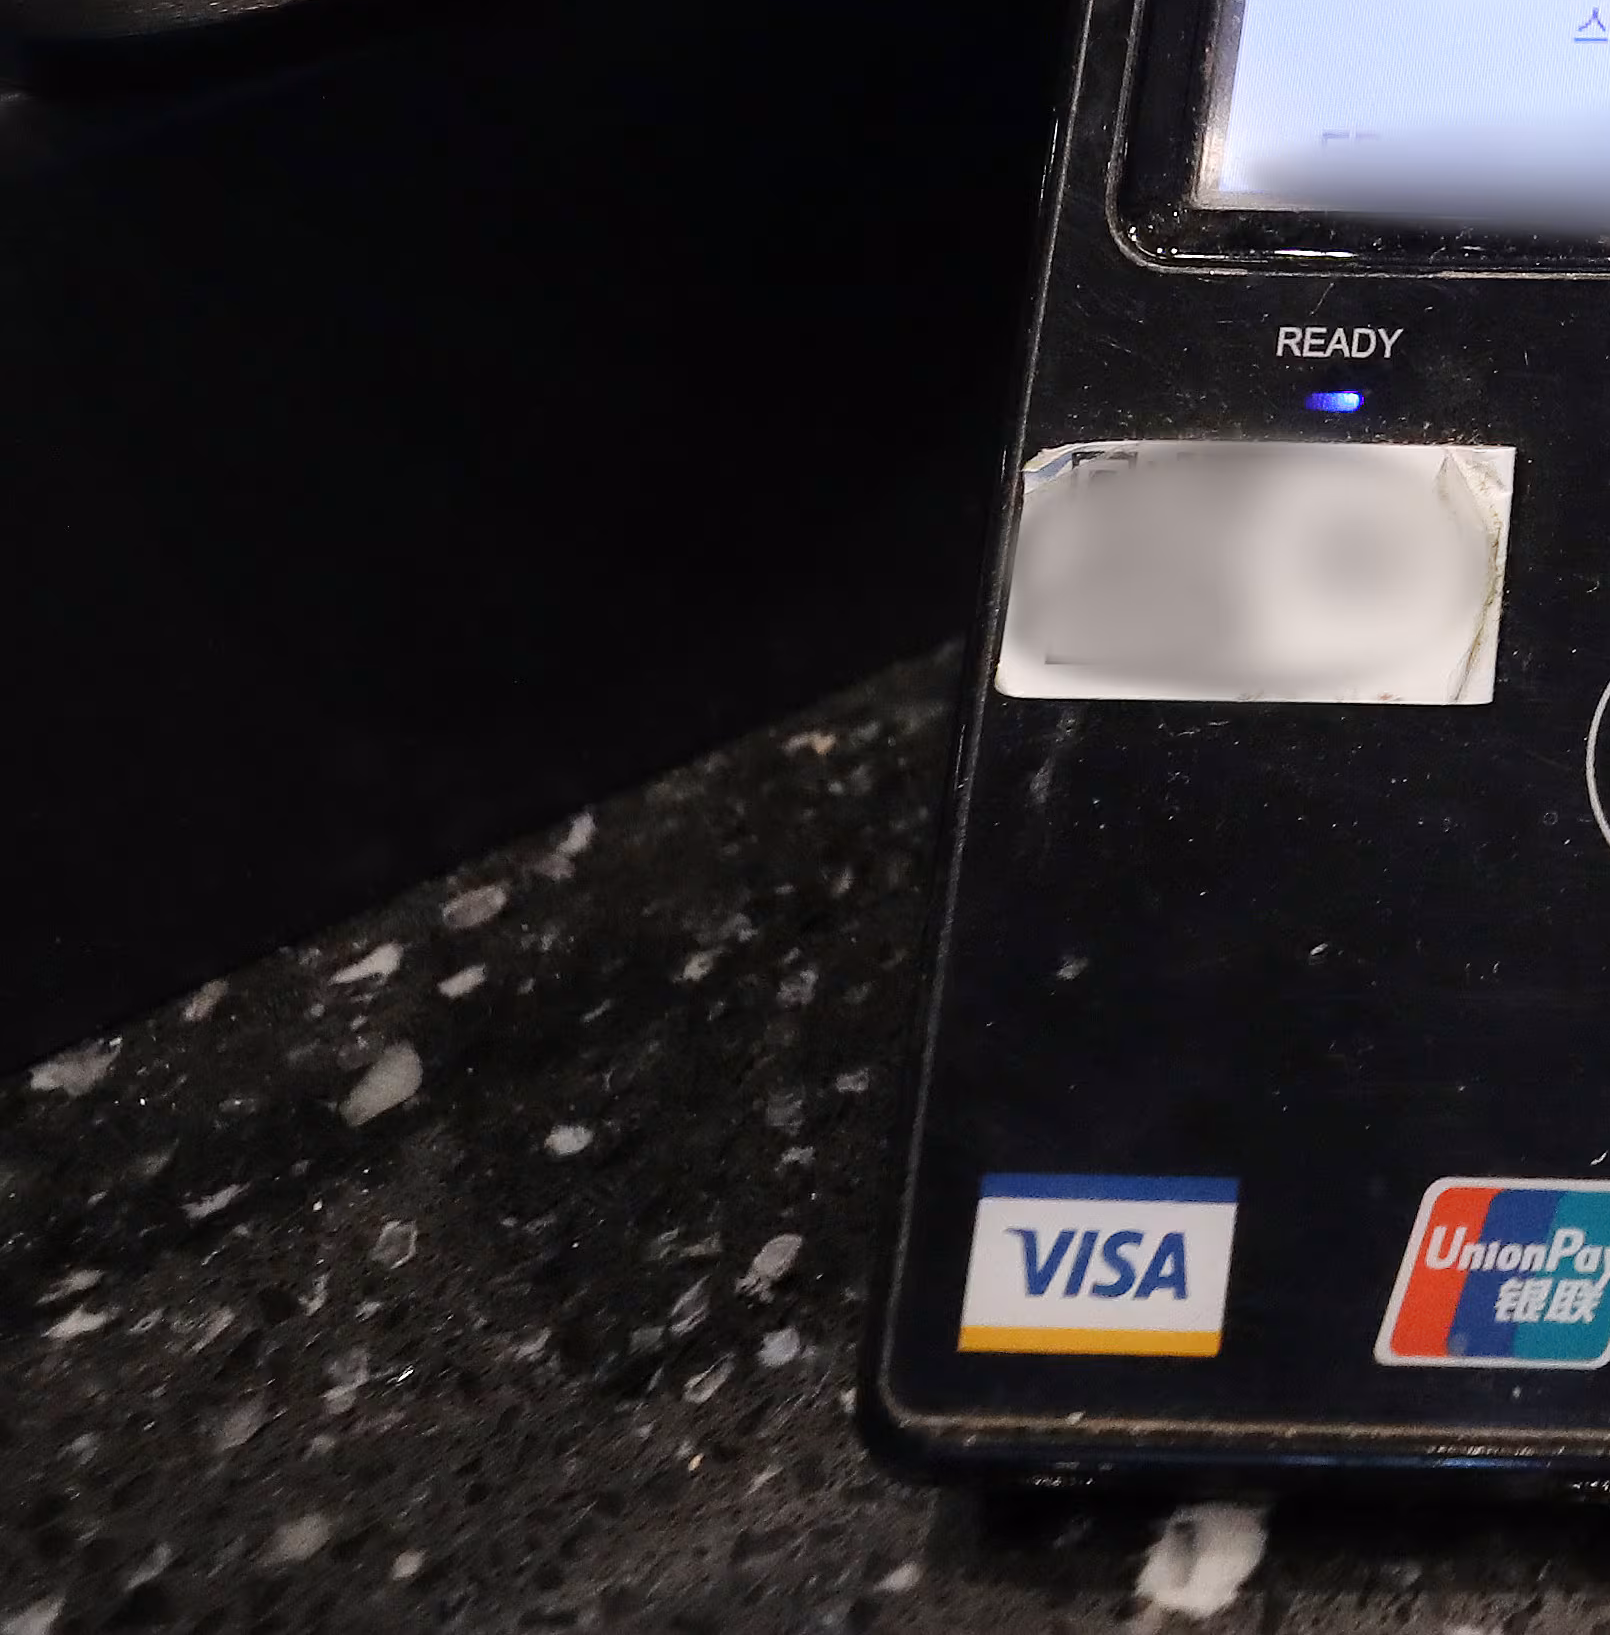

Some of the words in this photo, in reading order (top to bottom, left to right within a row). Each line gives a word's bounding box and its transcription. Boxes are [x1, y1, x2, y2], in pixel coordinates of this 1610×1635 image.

[1276, 327, 1403, 360] READY
[1007, 1227, 1190, 1301] VISA
[1494, 1278, 1602, 1326] 银联
